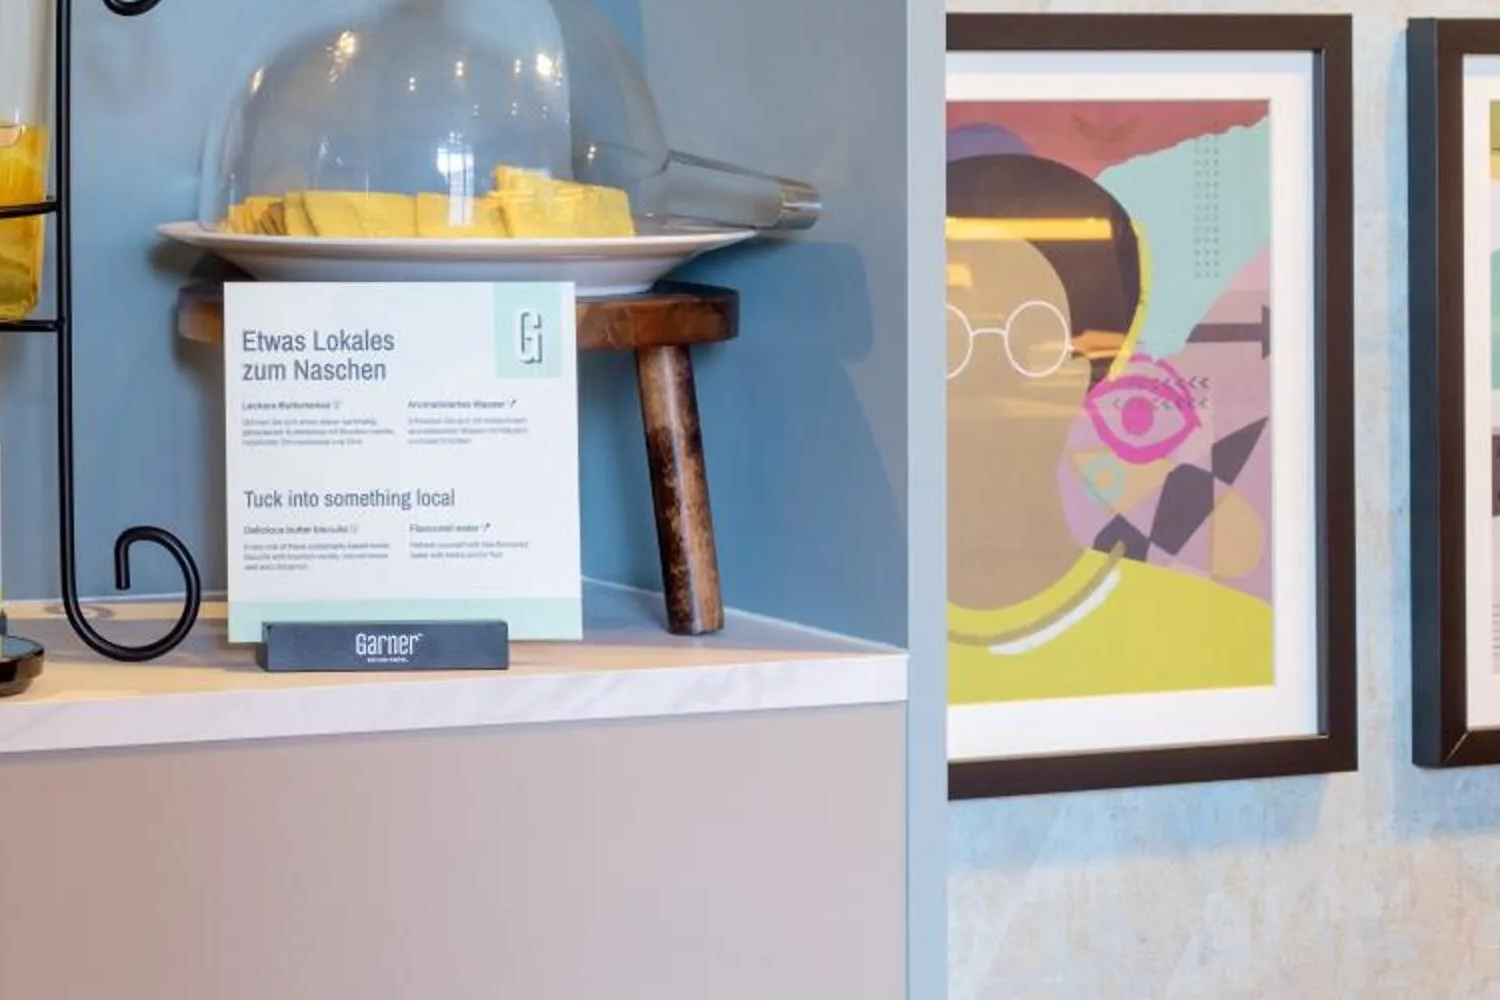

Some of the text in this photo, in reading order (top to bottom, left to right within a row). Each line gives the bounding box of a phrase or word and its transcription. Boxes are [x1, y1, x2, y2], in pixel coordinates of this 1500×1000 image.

[242, 328, 395, 353] Etwas Lokales
[242, 358, 387, 382] zum Naschen
[244, 487, 456, 512] Tuck into something local
